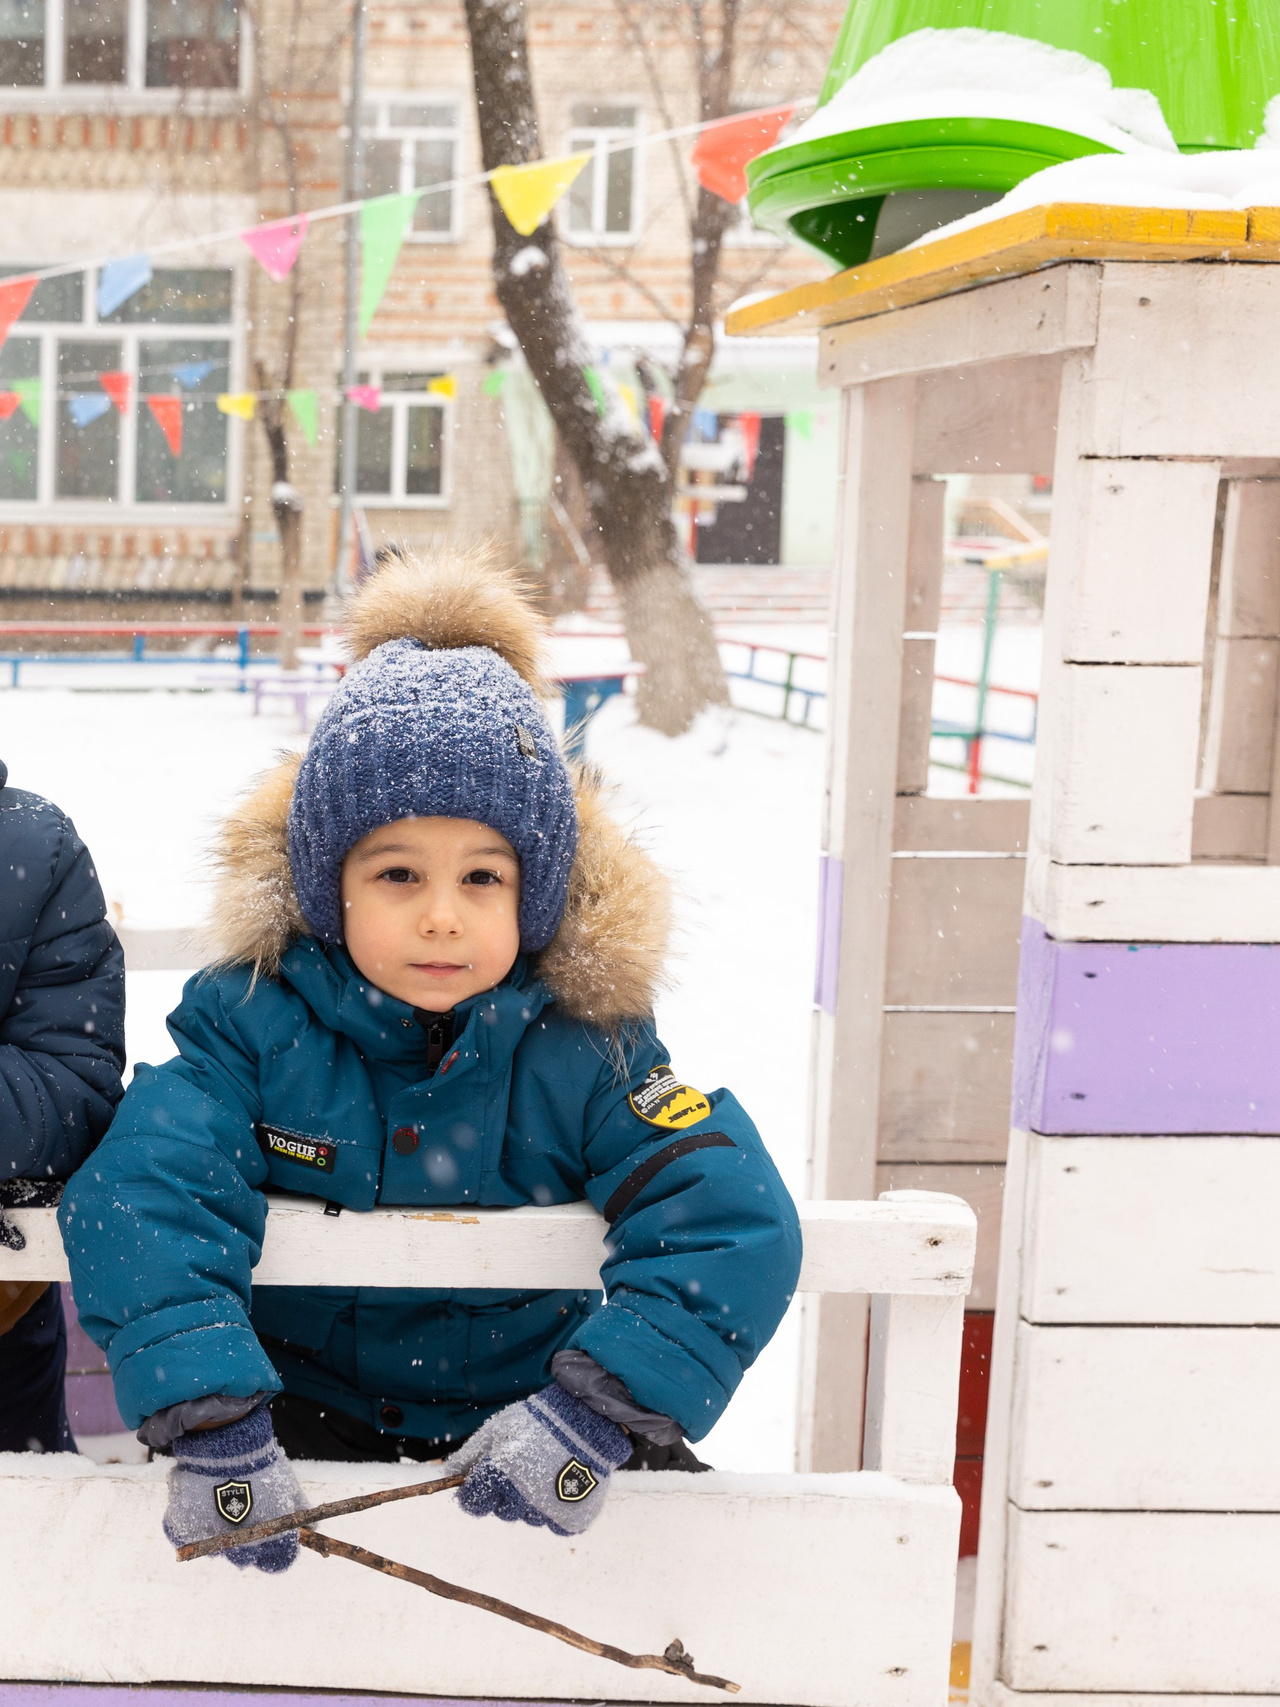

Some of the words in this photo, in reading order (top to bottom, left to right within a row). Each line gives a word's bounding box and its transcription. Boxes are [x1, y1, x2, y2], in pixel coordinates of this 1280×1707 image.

[267, 1133, 317, 1158] VOGUE
[572, 1466, 590, 1485] STYLE
[221, 1488, 245, 1497] STYLE
